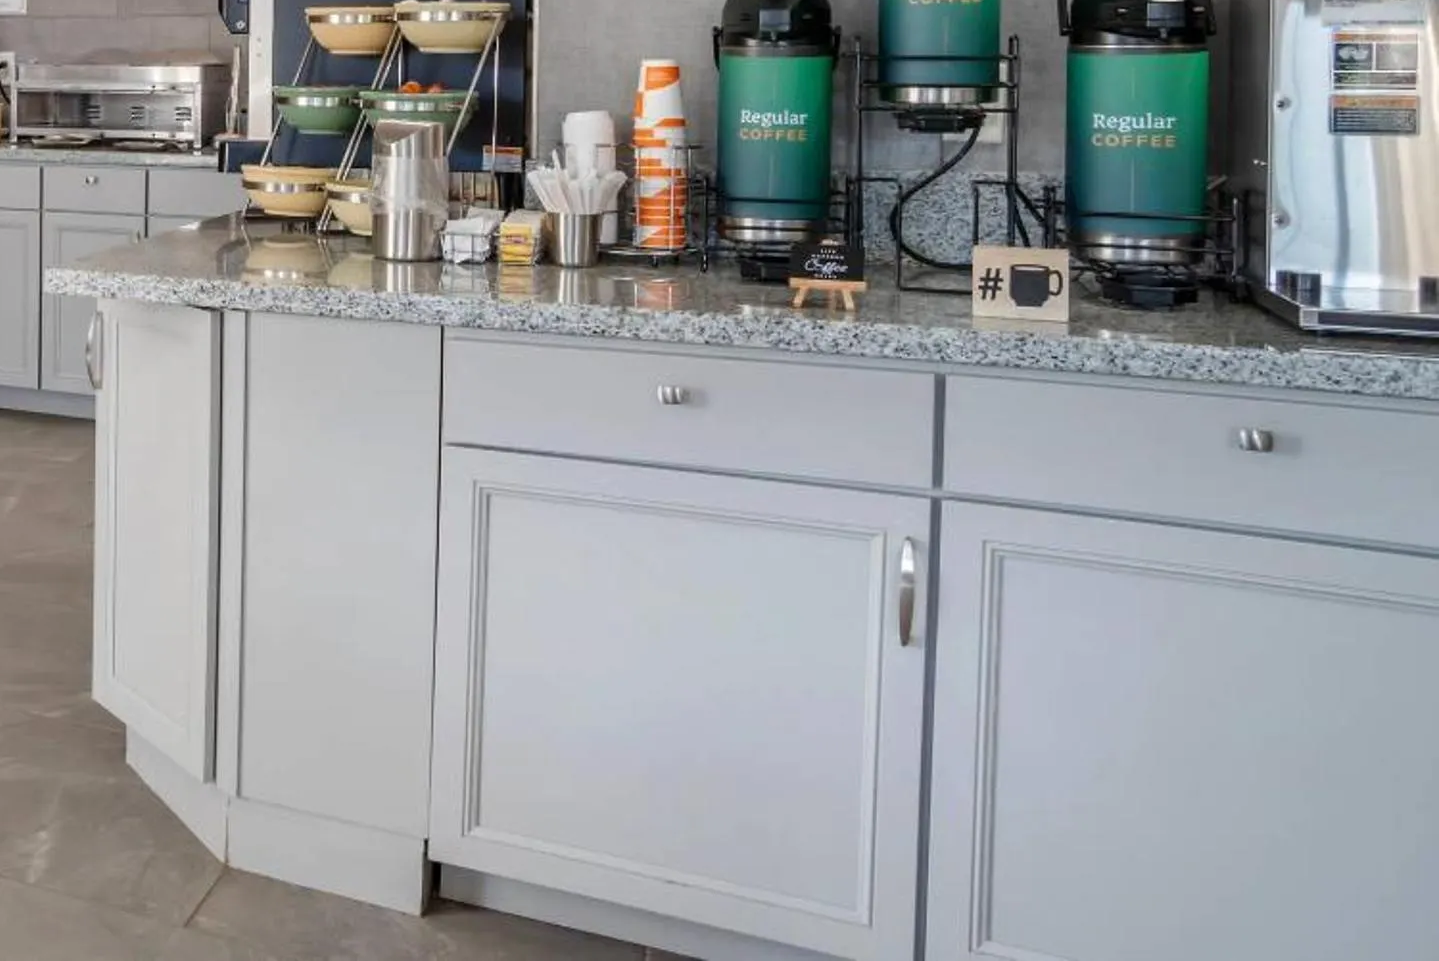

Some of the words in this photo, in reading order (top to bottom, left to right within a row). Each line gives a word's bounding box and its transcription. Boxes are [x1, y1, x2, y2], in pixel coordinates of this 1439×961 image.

[741, 108, 808, 128] Regular
[1092, 112, 1177, 133] Regular
[739, 128, 808, 141] COFFEE
[1091, 133, 1177, 148] COFFEE
